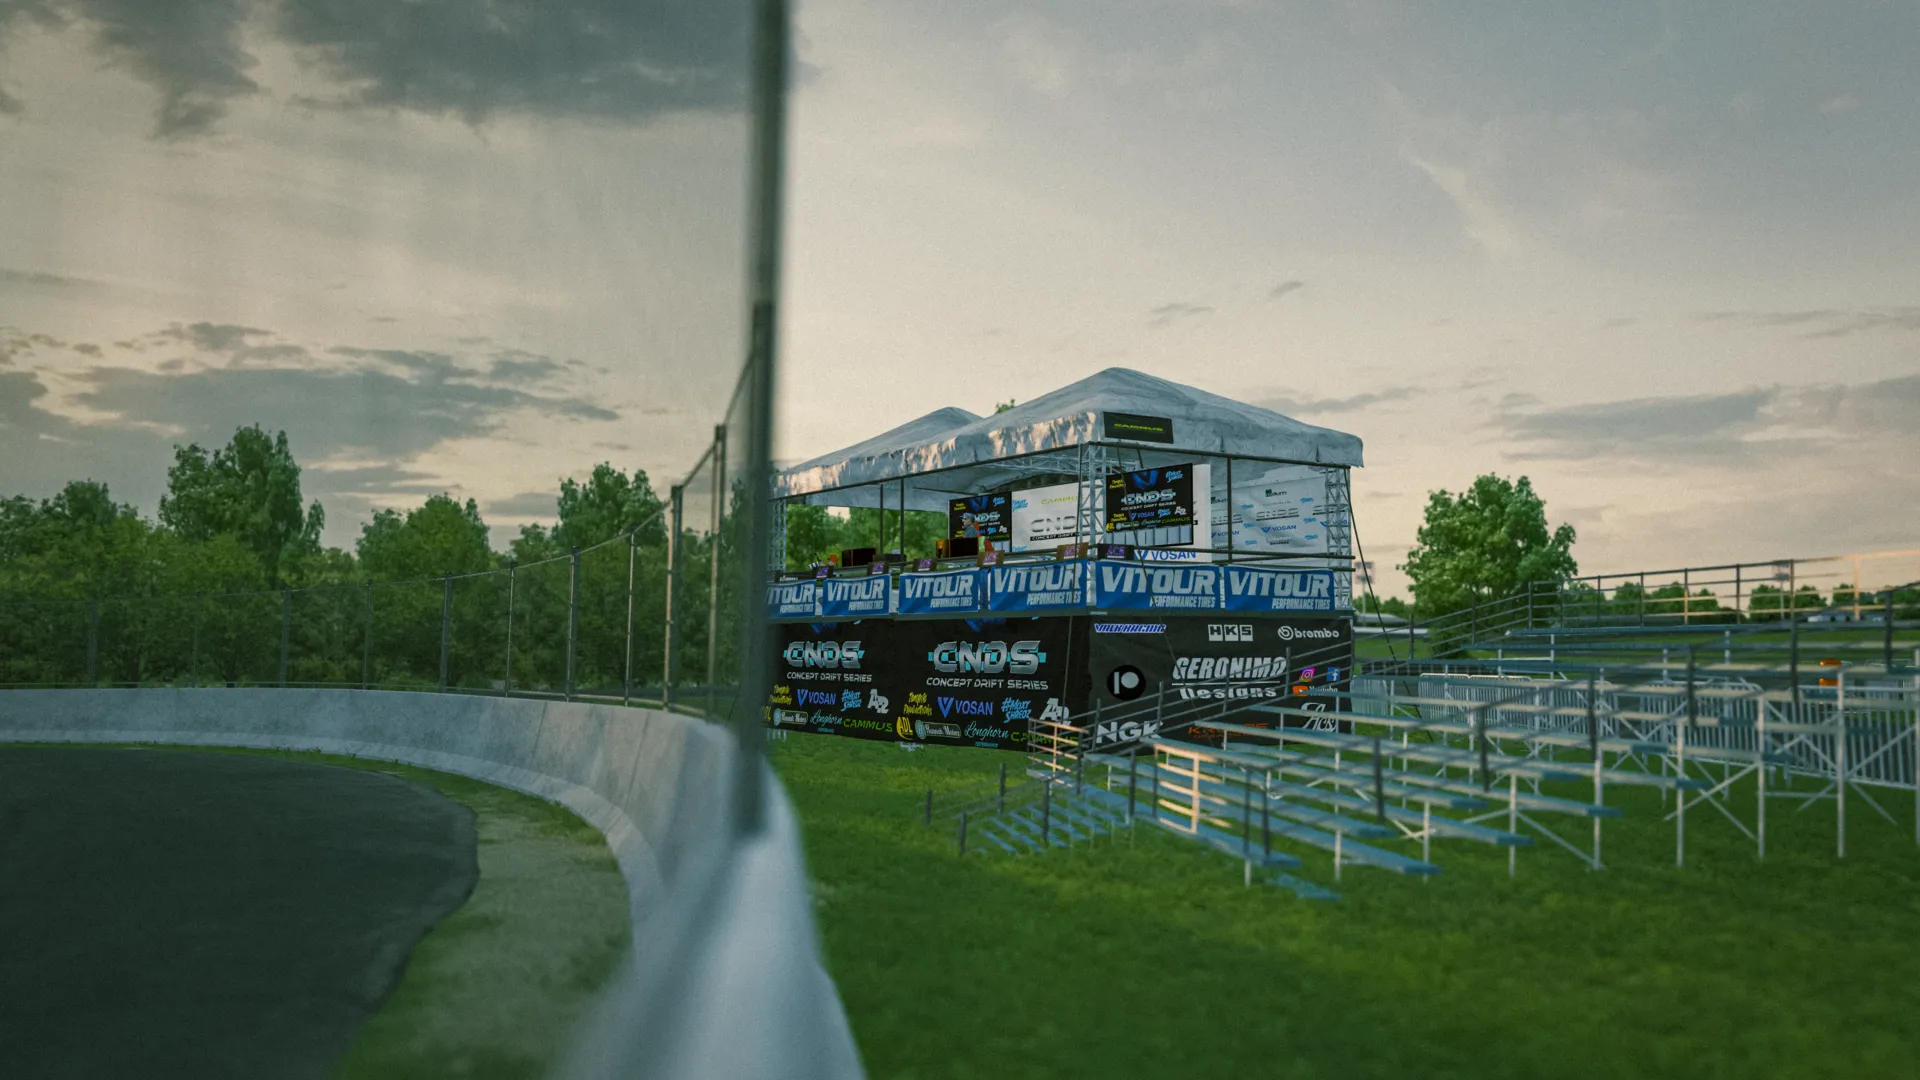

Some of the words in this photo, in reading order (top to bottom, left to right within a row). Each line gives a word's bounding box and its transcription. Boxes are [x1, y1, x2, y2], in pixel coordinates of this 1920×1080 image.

[1114, 423, 1163, 432] CAMMUS
[1122, 489, 1174, 505] CNDS
[1151, 551, 1196, 560] VOSAN
[994, 562, 1083, 593] VITOUR
[1101, 566, 1216, 596] VITOUR
[1229, 571, 1331, 597] VITOUR
[827, 579, 885, 601] VITOUR
[905, 574, 974, 598] VITOUR
[1149, 596, 1198, 608] PERFORMANCE
[1198, 597, 1216, 608] TIRES
[1271, 598, 1312, 609] PERFORMANCE
[1313, 599, 1331, 610] TIRES
[1208, 625, 1253, 641] HKS
[1295, 628, 1340, 639] brembo
[786, 640, 862, 668] CNDS
[933, 641, 1041, 674] CNDS
[1172, 656, 1287, 680] GERONIMO
[786, 672, 818, 680] CONCEPT
[820, 672, 841, 681] DRIFT
[843, 673, 872, 682] SERIES
[926, 677, 972, 688] CONCEPT
[974, 679, 1004, 688] DRIFT
[1007, 680, 1048, 690] SERIES
[808, 691, 836, 705] VOSAN
[1179, 687, 1277, 700] Designs
[955, 701, 994, 715] VOSAN
[843, 719, 893, 732] CAMMUS
[964, 720, 1009, 740] Longhorn
[1096, 721, 1163, 743] NGK
